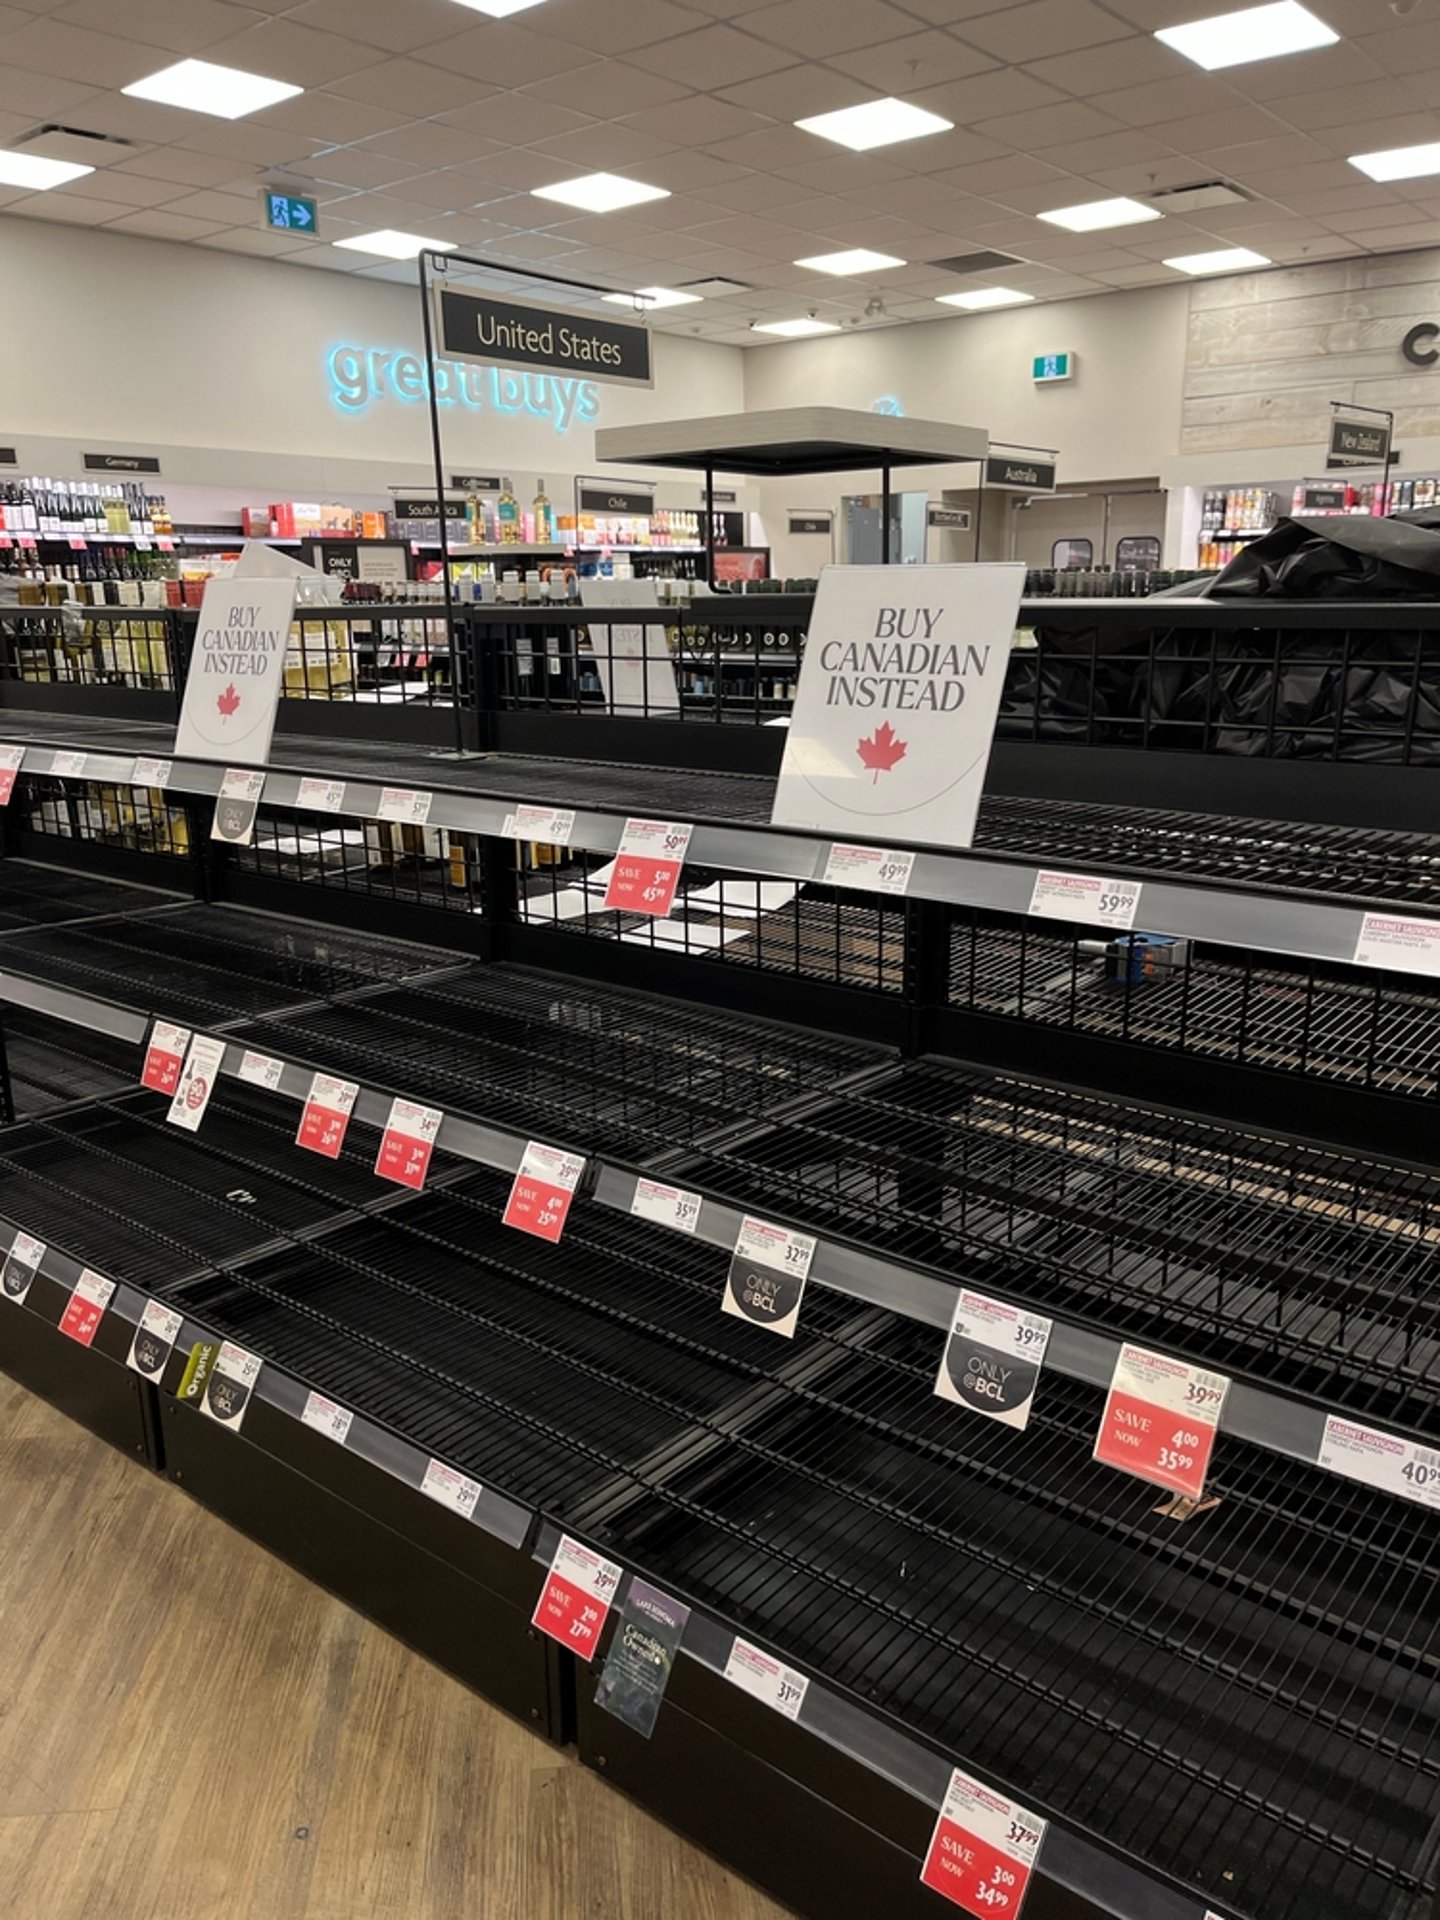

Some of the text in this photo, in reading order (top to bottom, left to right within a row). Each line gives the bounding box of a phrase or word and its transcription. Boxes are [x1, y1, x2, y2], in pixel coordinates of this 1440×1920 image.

[476, 313, 622, 366] United States
[493, 368, 600, 430] buys
[105, 457, 139, 469] Germany
[1005, 467, 1038, 483] Australia
[408, 504, 433, 516] South
[608, 497, 627, 510] Chile
[228, 607, 261, 628] BUY
[874, 607, 944, 639] BUY
[202, 629, 280, 651] CANADIAN
[204, 653, 268, 676] INSTEAD
[819, 641, 991, 677] CANADIAN
[825, 676, 966, 712] INSTEAD
[617, 867, 642, 881] SAVE
[616, 882, 634, 892] NOW
[385, 1140, 404, 1153] SAVE
[517, 1187, 537, 1202] SAVE
[515, 1202, 531, 1213] NOW
[746, 1274, 782, 1297] ONLY
[742, 1289, 777, 1314] @BCL
[186, 1344, 213, 1396] Organic
[967, 1357, 1013, 1383] ONLY
[963, 1372, 1005, 1402] @BCL
[1113, 1408, 1152, 1433] SAVE
[1113, 1430, 1143, 1448] NOW
[548, 1586, 573, 1608] SAVE
[547, 1602, 564, 1618] NOW
[625, 1623, 667, 1657] Canadian
[940, 1835, 975, 1865] SAVE
[940, 1857, 965, 1878] NOW
